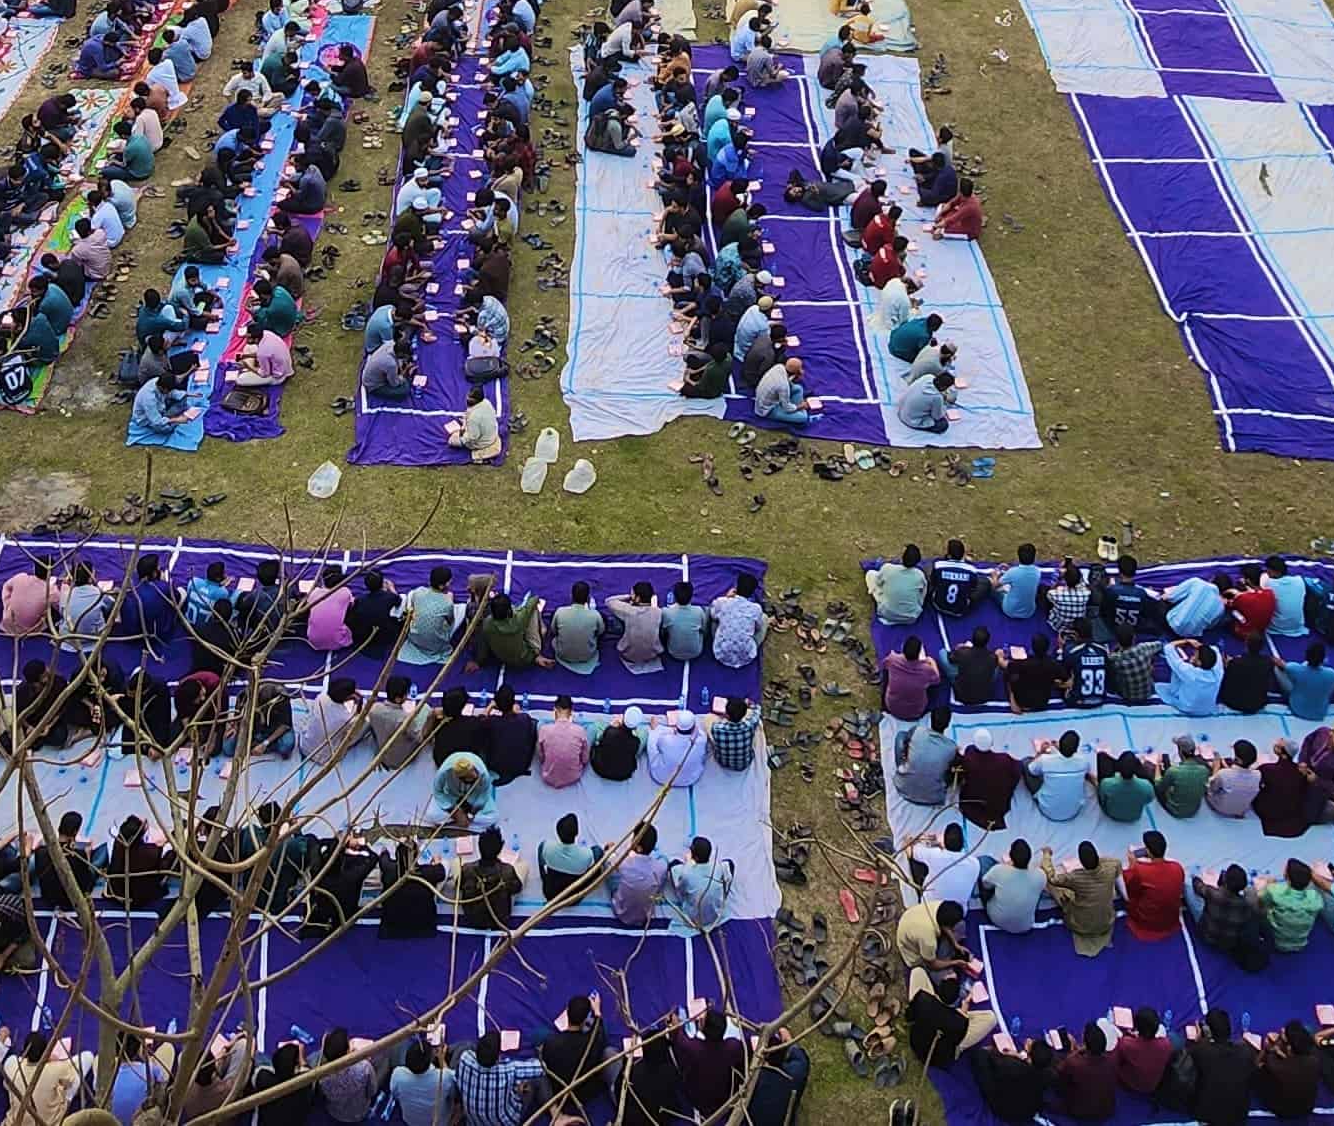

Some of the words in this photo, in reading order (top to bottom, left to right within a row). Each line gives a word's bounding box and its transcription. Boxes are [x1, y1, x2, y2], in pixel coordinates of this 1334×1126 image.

[5, 366, 25, 390] 07
[946, 584, 959, 604] 8
[1114, 608, 1140, 626] 55
[1080, 669, 1106, 695] 33
